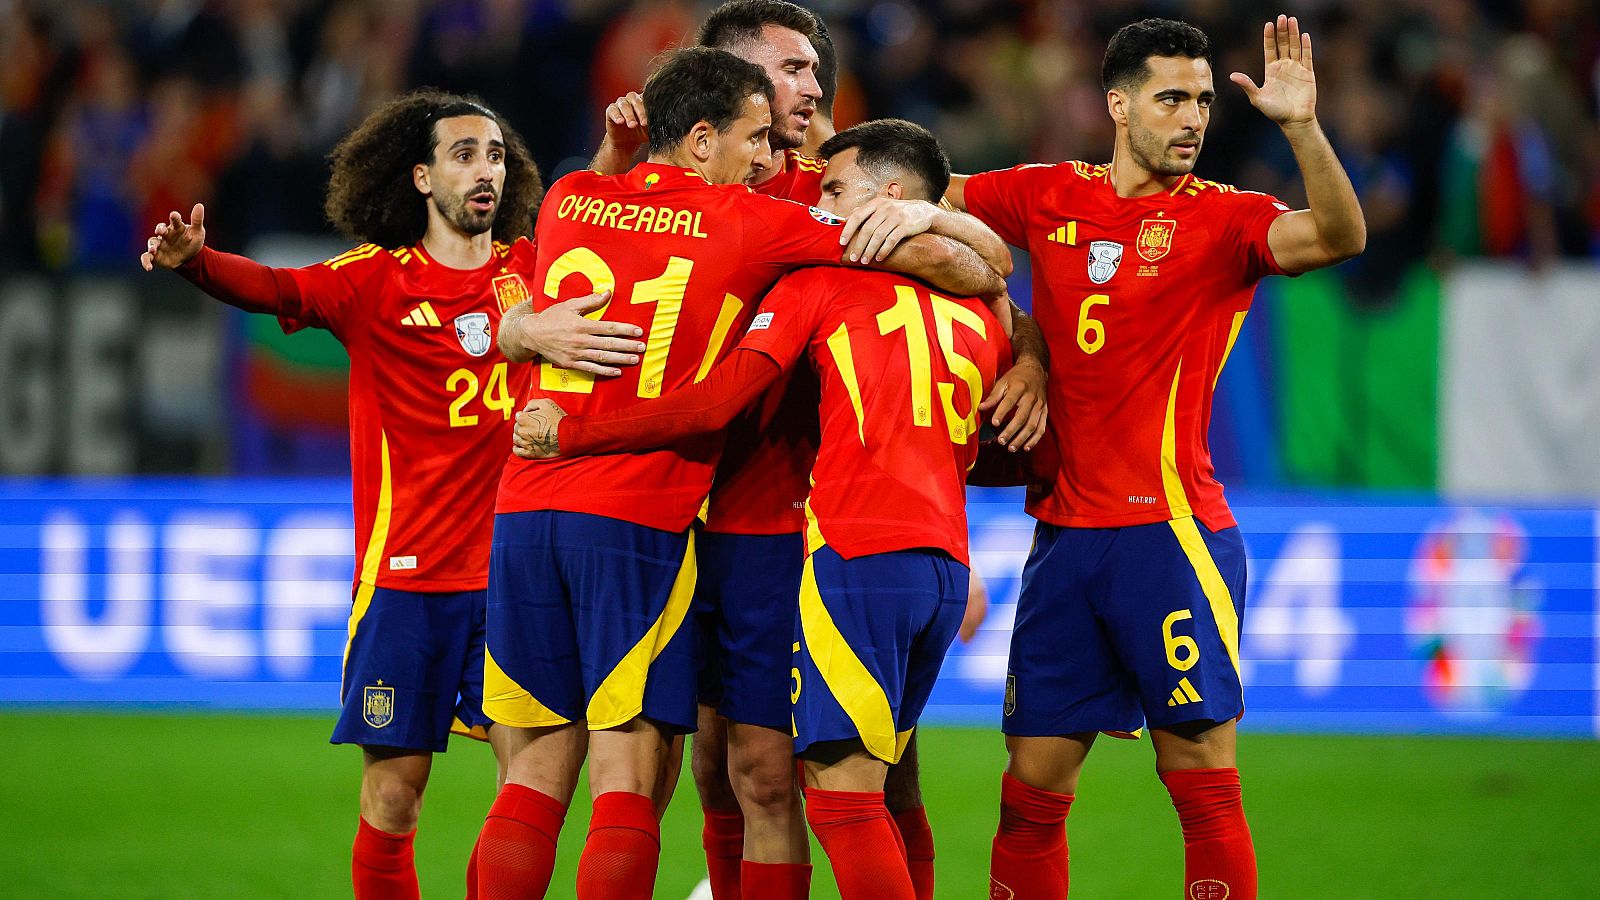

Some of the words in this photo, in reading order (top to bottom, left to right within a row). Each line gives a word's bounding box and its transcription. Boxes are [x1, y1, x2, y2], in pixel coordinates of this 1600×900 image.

[557, 194, 709, 239] OYARZABAL
[540, 246, 695, 399] 21
[1076, 293, 1110, 355] 6
[446, 362, 516, 428] 24
[875, 284, 988, 446] 15
[792, 501, 806, 509] HEAT
[38, 508, 354, 682] UEF
[1162, 608, 1200, 672] 6
